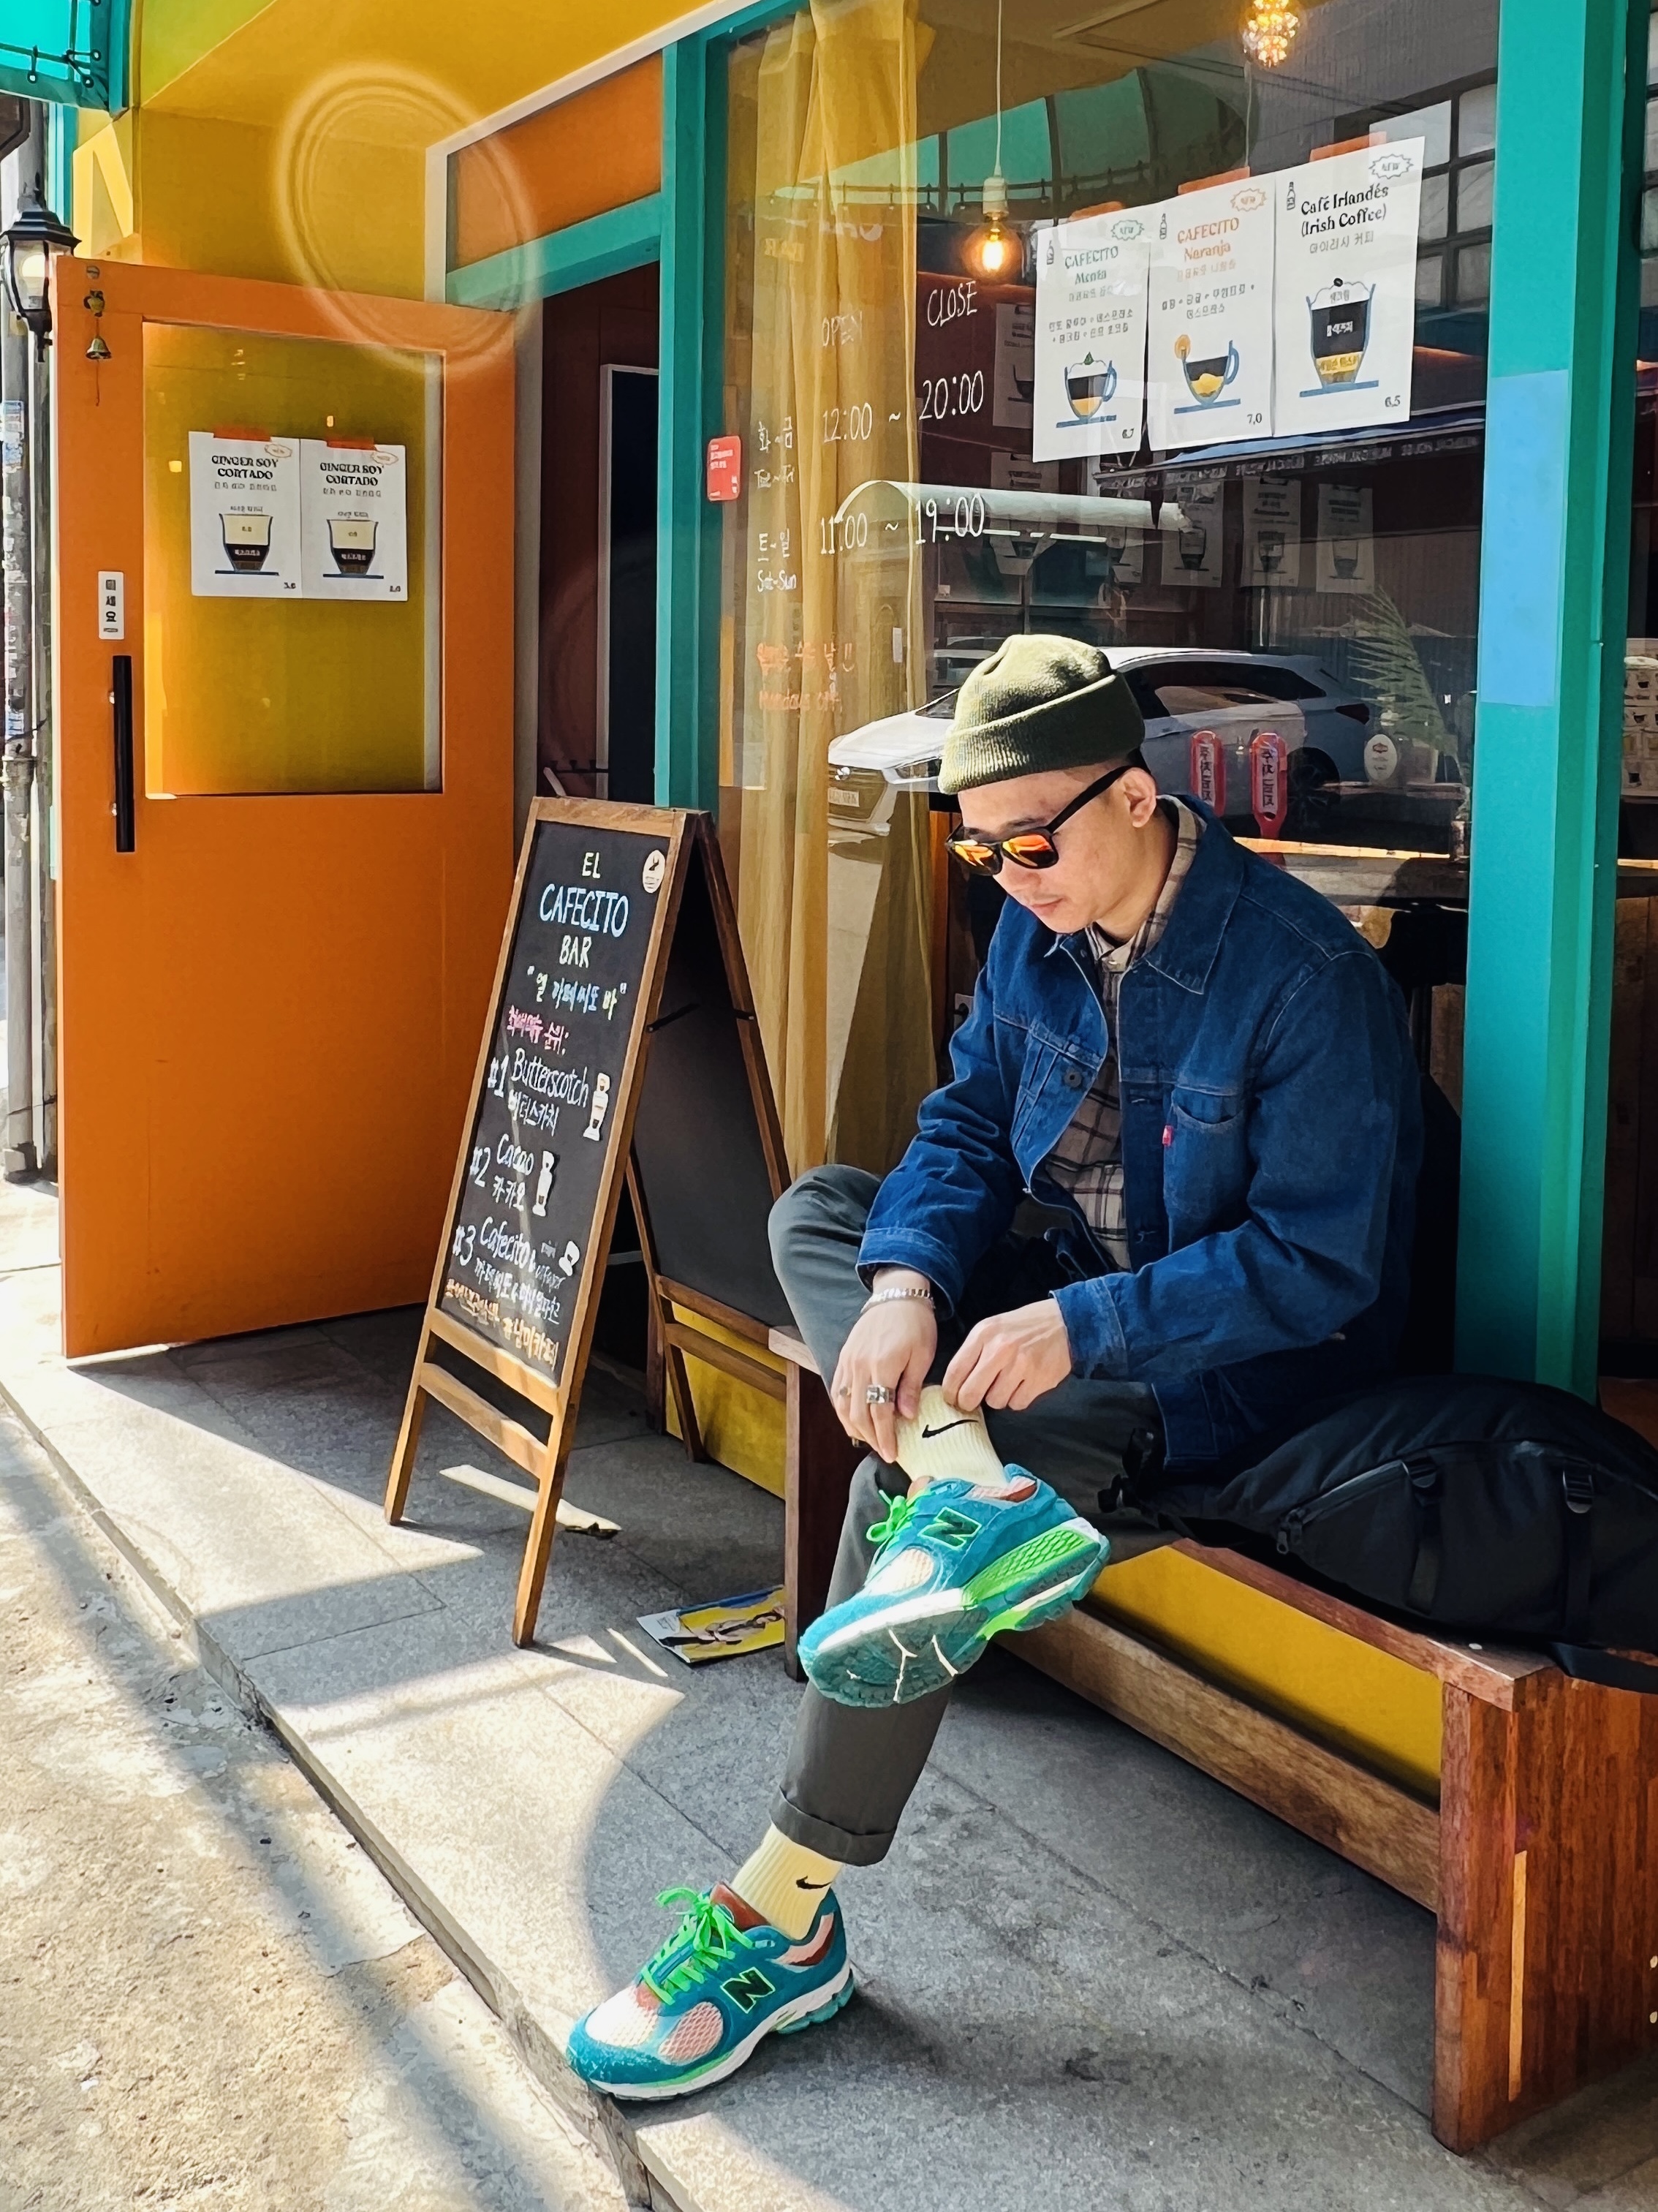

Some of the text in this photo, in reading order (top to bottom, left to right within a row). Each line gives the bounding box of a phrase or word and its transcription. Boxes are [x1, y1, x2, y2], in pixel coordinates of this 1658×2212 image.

[1301, 184, 1389, 216] Café Irlandés
[1177, 217, 1240, 244] CAFECITO
[1301, 203, 1387, 237] (Irish Coffee)
[1064, 246, 1118, 269] CAFECITO
[927, 281, 977, 327] CLOSE
[823, 402, 872, 444] 12:00
[919, 370, 983, 420] 20:00
[915, 493, 985, 543] 19:00
[582, 852, 601, 878] EL
[540, 883, 629, 937] CAFECITO
[559, 935, 592, 968] BAR
[510, 1047, 590, 1108] Butterscotch
[496, 1133, 534, 1176] Cacao
